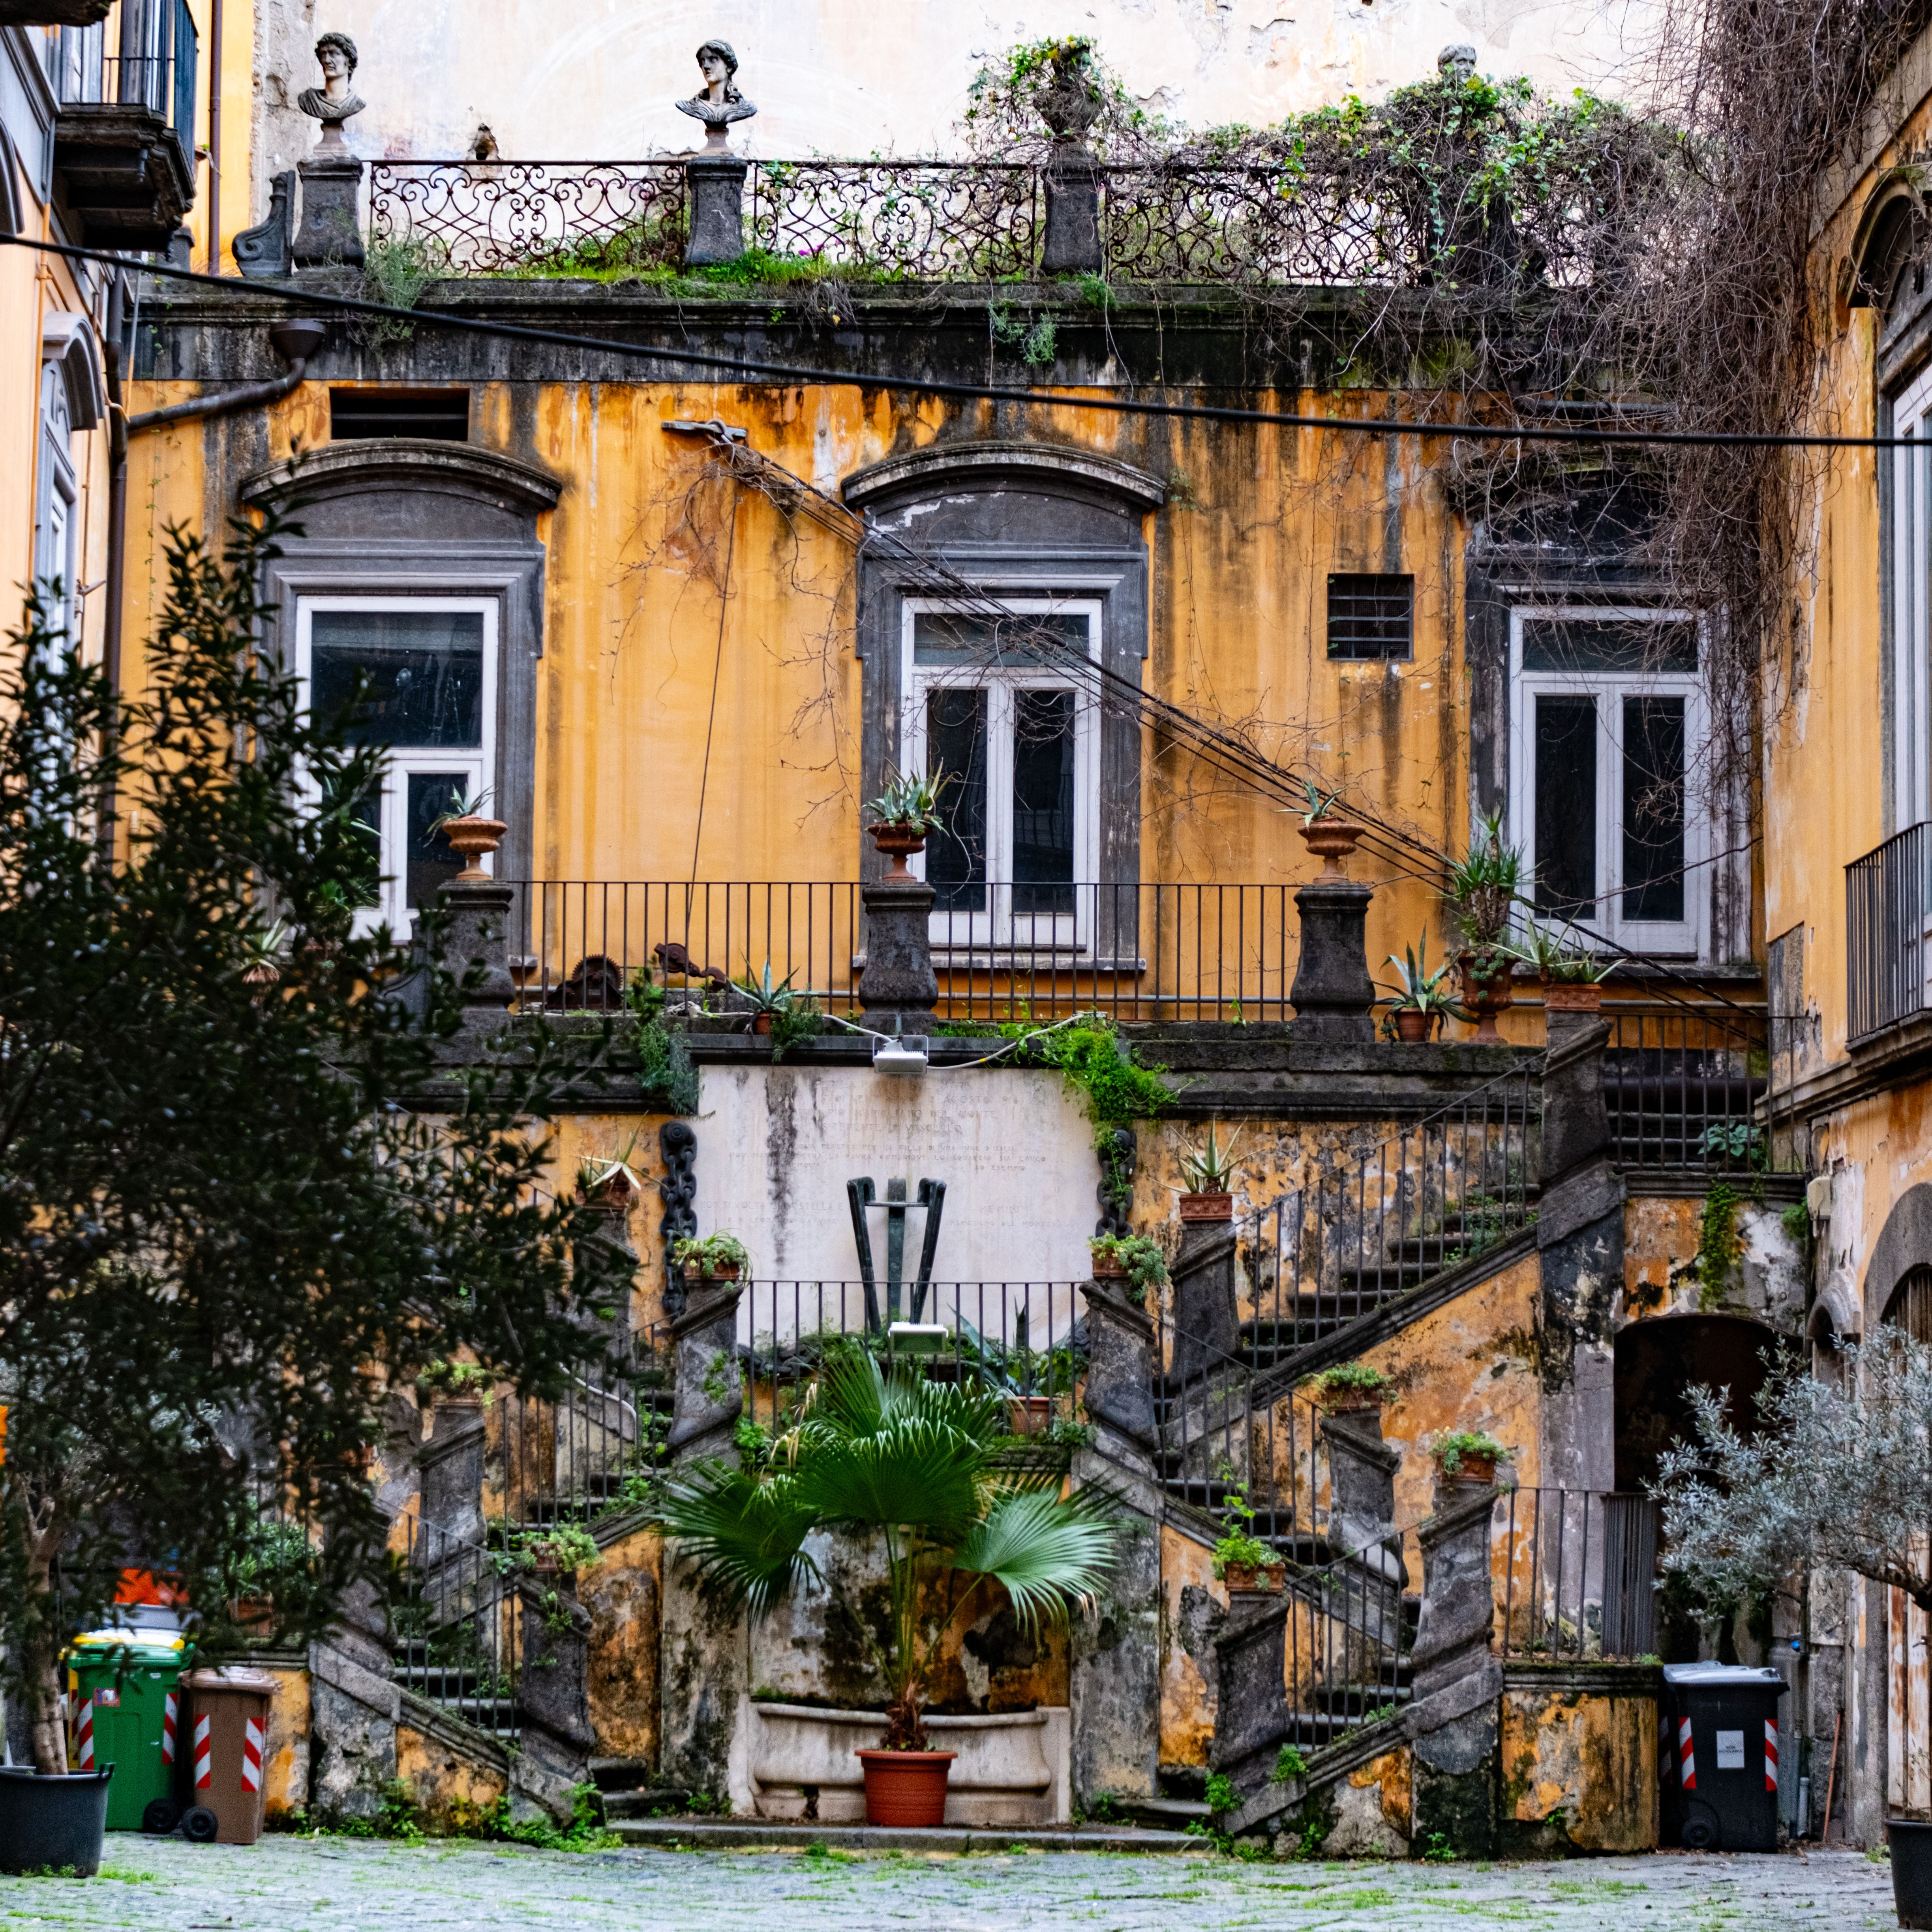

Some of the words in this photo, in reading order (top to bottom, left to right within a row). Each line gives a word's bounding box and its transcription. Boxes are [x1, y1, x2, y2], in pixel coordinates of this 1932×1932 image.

[930, 1110, 951, 1118] DEL
[905, 1124, 962, 1133] VASCELLO
[799, 1202, 833, 1210] STELLA
